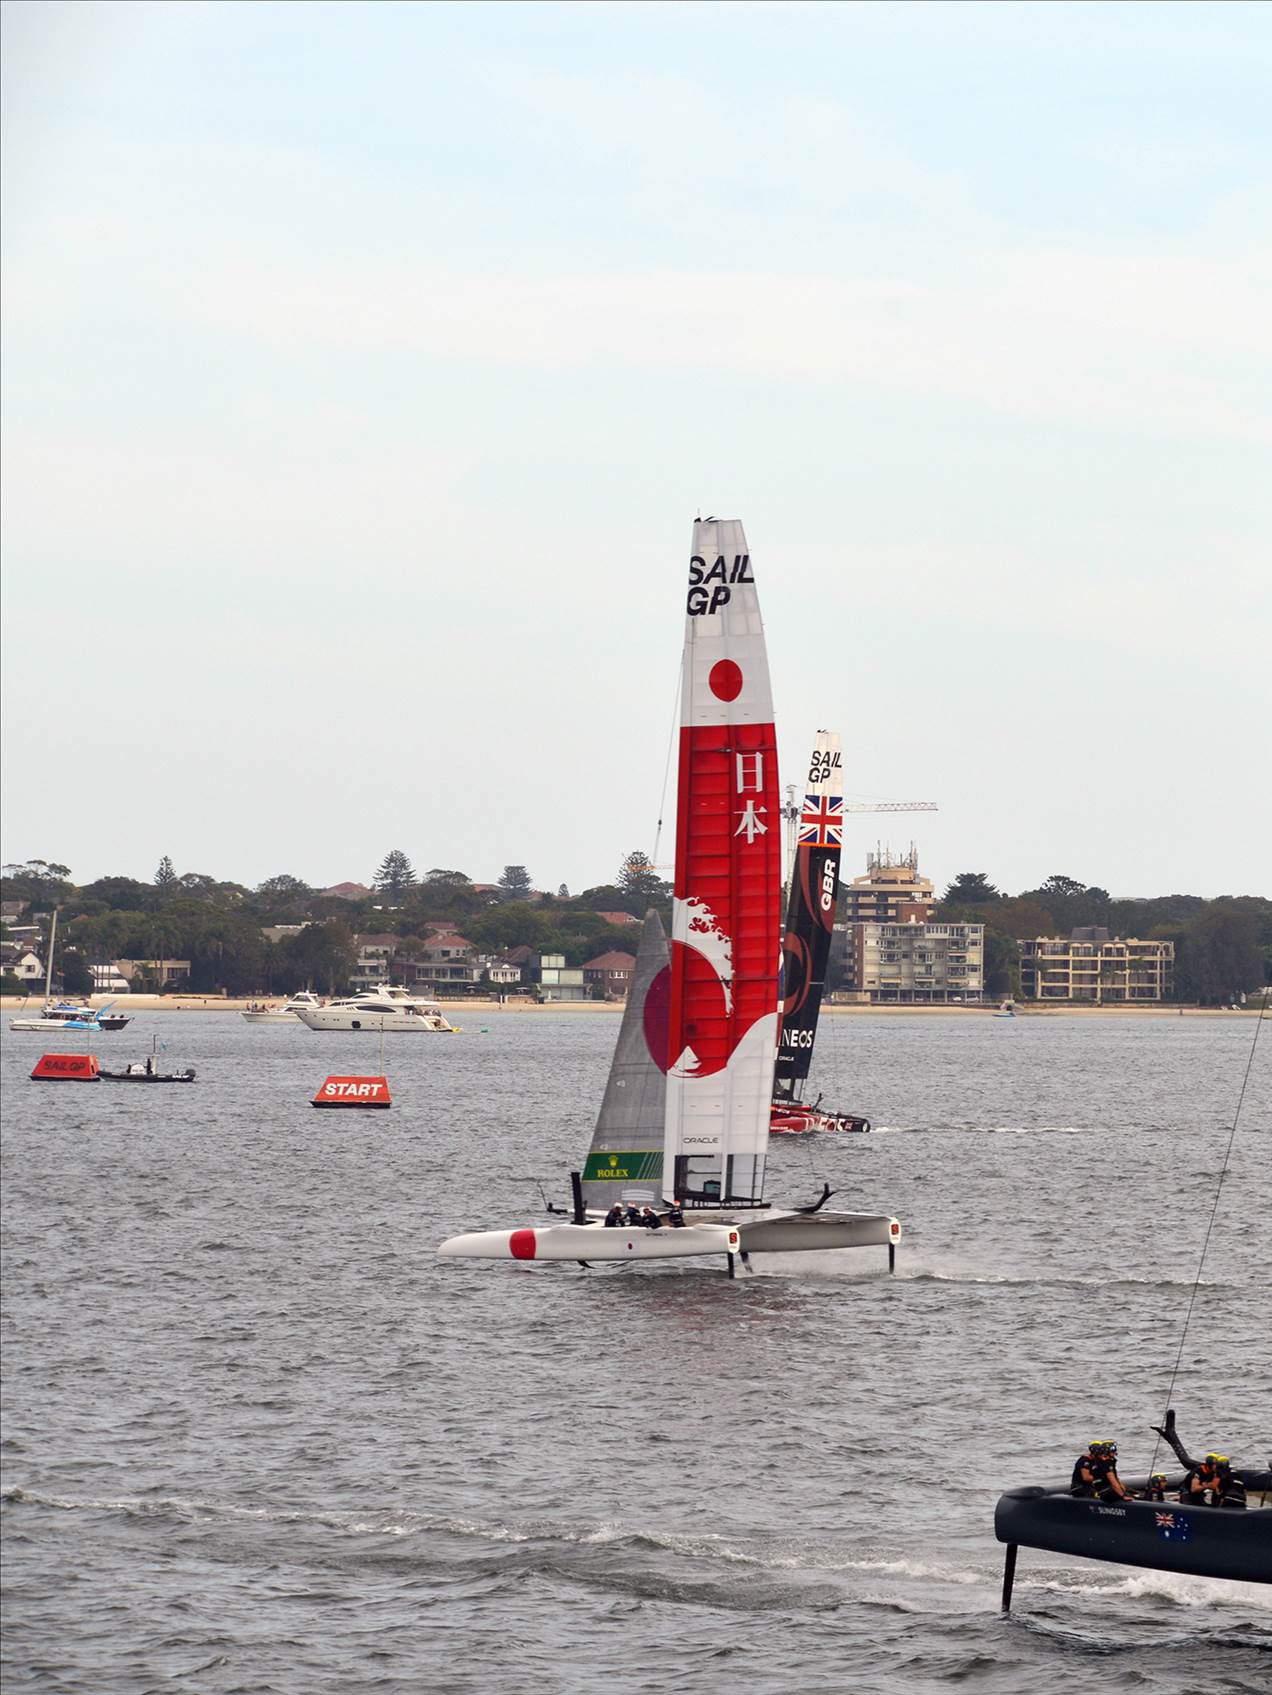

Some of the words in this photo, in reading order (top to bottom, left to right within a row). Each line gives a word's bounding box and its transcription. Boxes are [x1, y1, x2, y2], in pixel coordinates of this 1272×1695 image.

[688, 554, 755, 585] SAIL
[686, 586, 731, 616] GP
[811, 750, 842, 768] SAIL
[808, 768, 831, 783] GP
[733, 752, 768, 844] 日本
[821, 858, 836, 911] GBR
[325, 1083, 383, 1096] START
[597, 1169, 628, 1178] ROLEX
